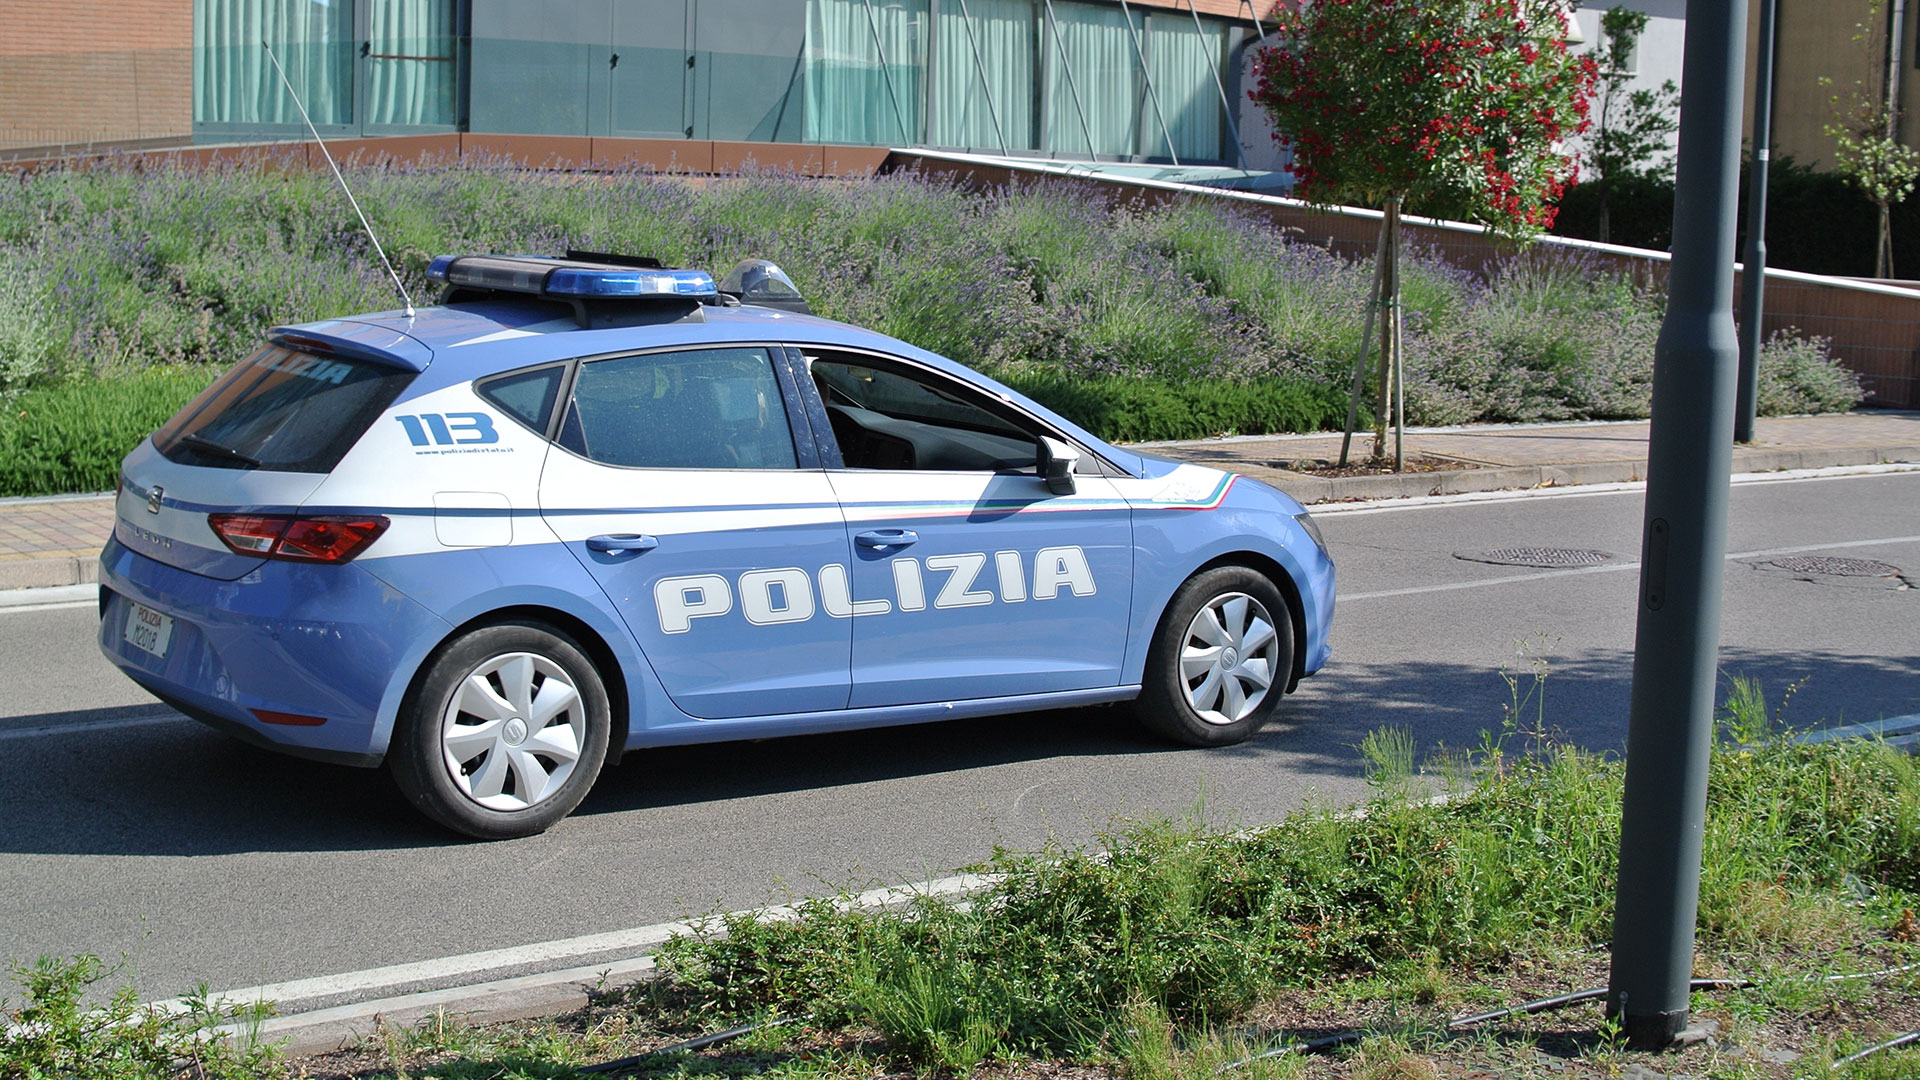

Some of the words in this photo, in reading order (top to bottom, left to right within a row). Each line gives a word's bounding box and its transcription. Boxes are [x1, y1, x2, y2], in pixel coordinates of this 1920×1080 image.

[394, 412, 499, 446] 113
[134, 527, 172, 549] LEON
[653, 545, 1097, 635] POLIZIA
[137, 607, 162, 629] POLIZIA
[132, 624, 158, 651] M2018
